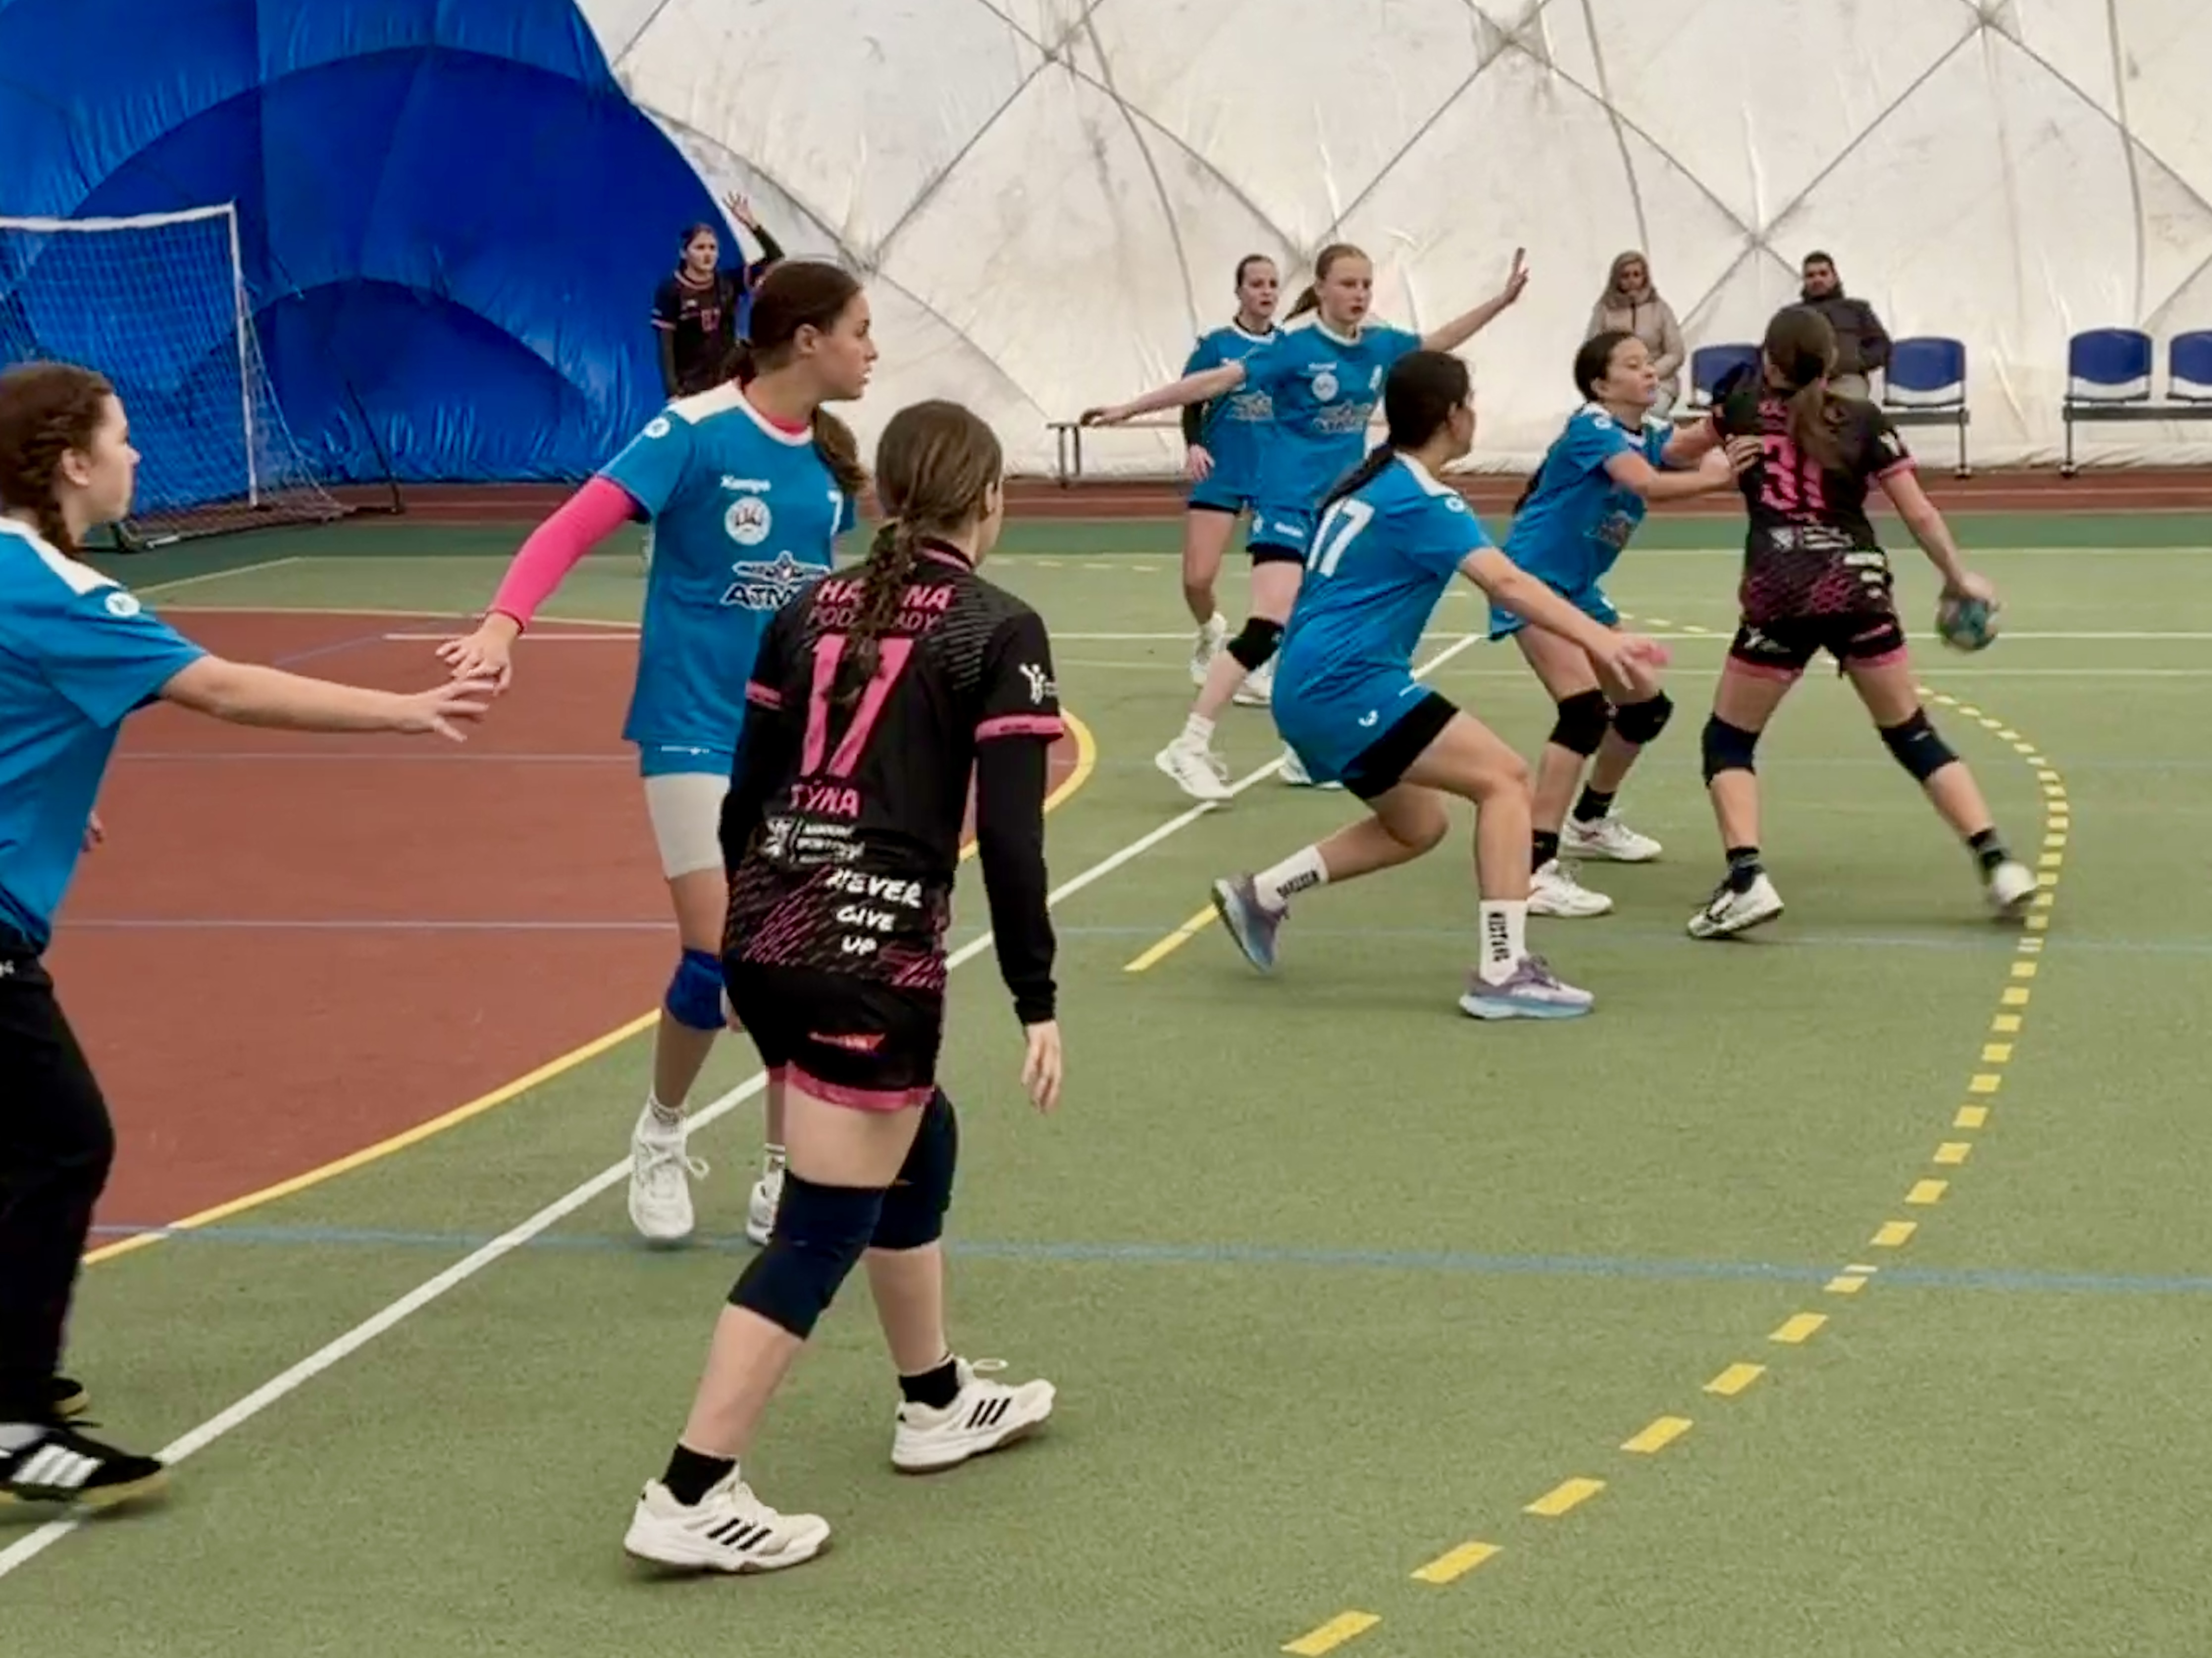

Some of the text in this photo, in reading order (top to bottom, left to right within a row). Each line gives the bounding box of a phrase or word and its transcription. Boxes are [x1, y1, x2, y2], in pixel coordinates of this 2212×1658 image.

[1306, 496, 1375, 577] 17
[800, 634, 914, 778] 17
[825, 868, 922, 908] NEVER
[836, 905, 895, 932] GIVE
[842, 934, 877, 956] UP
